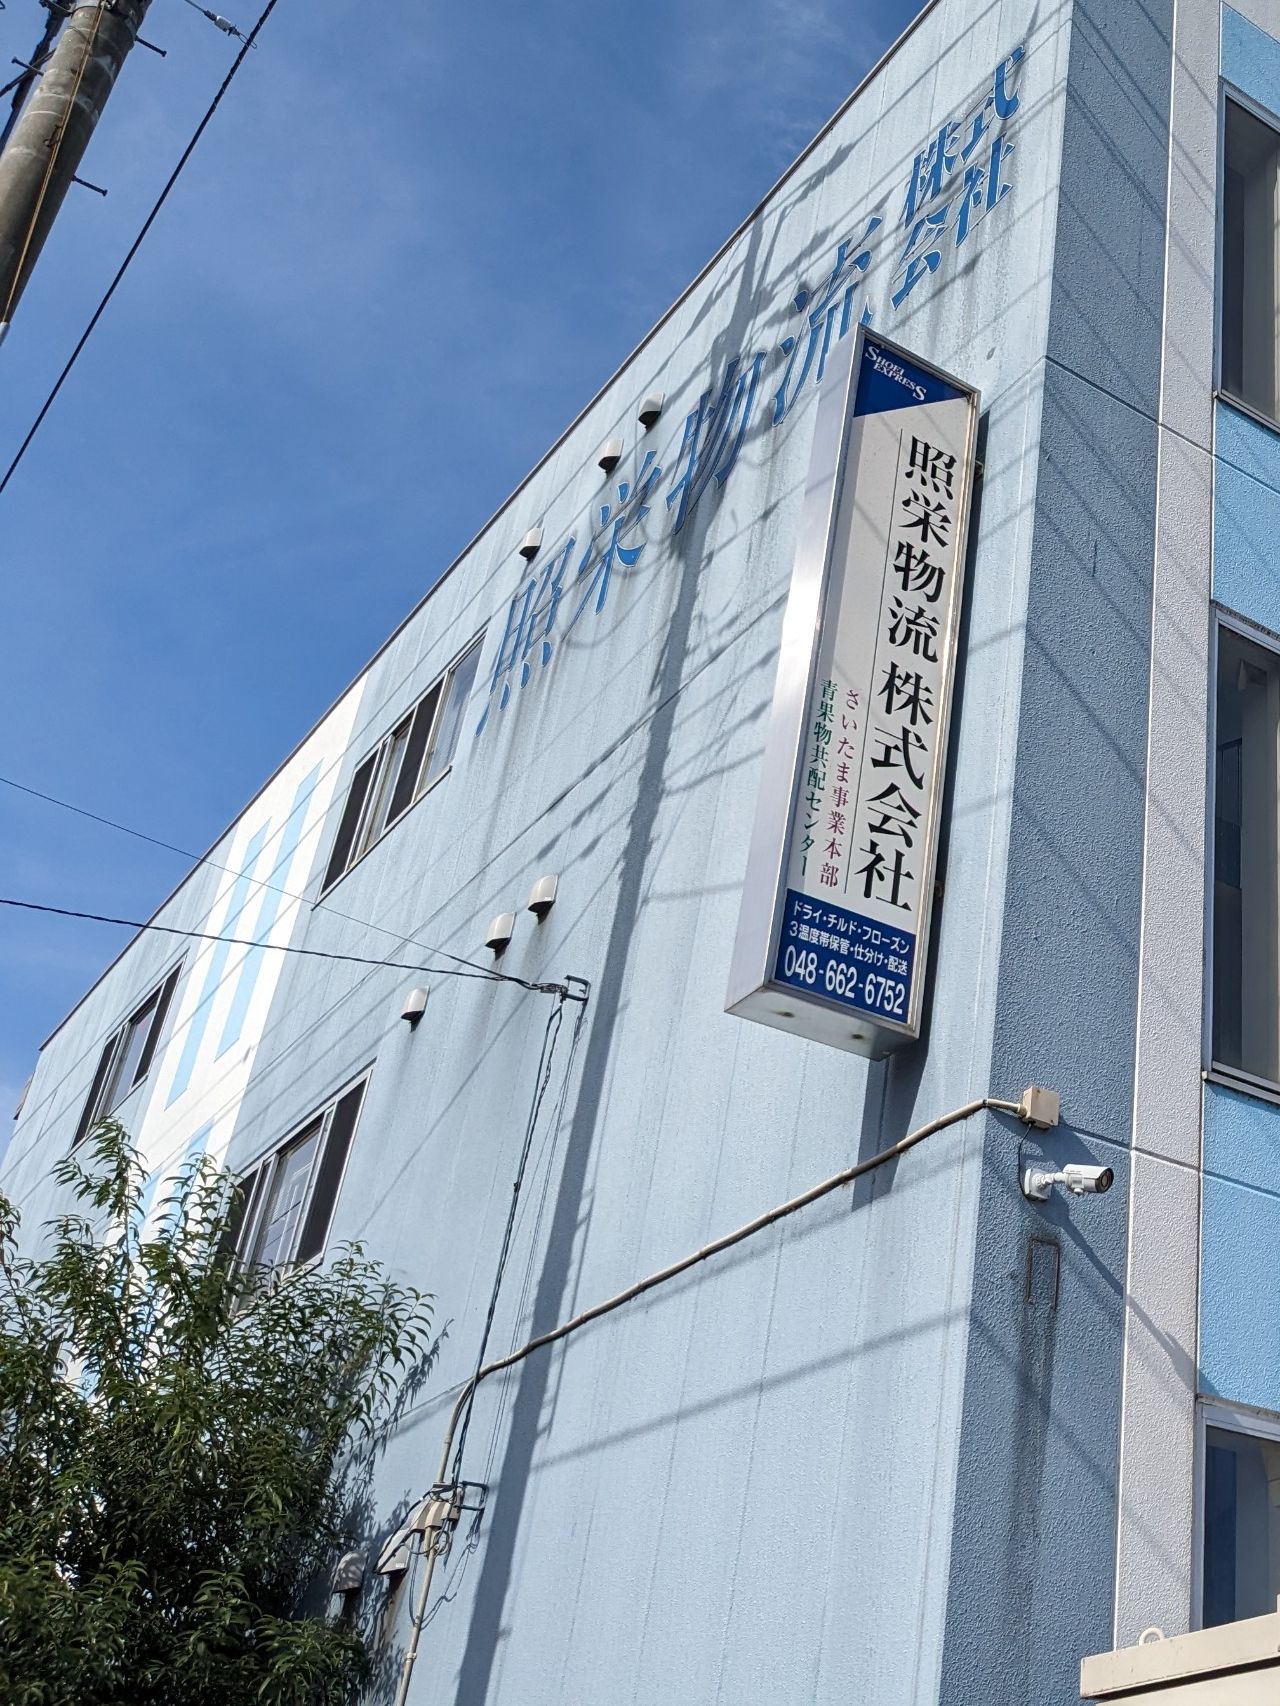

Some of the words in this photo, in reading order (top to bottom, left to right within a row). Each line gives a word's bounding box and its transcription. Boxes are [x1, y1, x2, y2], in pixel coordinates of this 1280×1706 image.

[865, 346, 905, 376] SHOEI
[873, 362, 927, 401] EXPRESS
[853, 435, 957, 912] 照栄物流株式会社
[799, 679, 838, 877] 青果物共配センター
[819, 688, 860, 888] さいたま事業本部
[793, 900, 910, 954] ドライ・チルド・フローズン
[784, 944, 906, 1015] 048-662-6752
